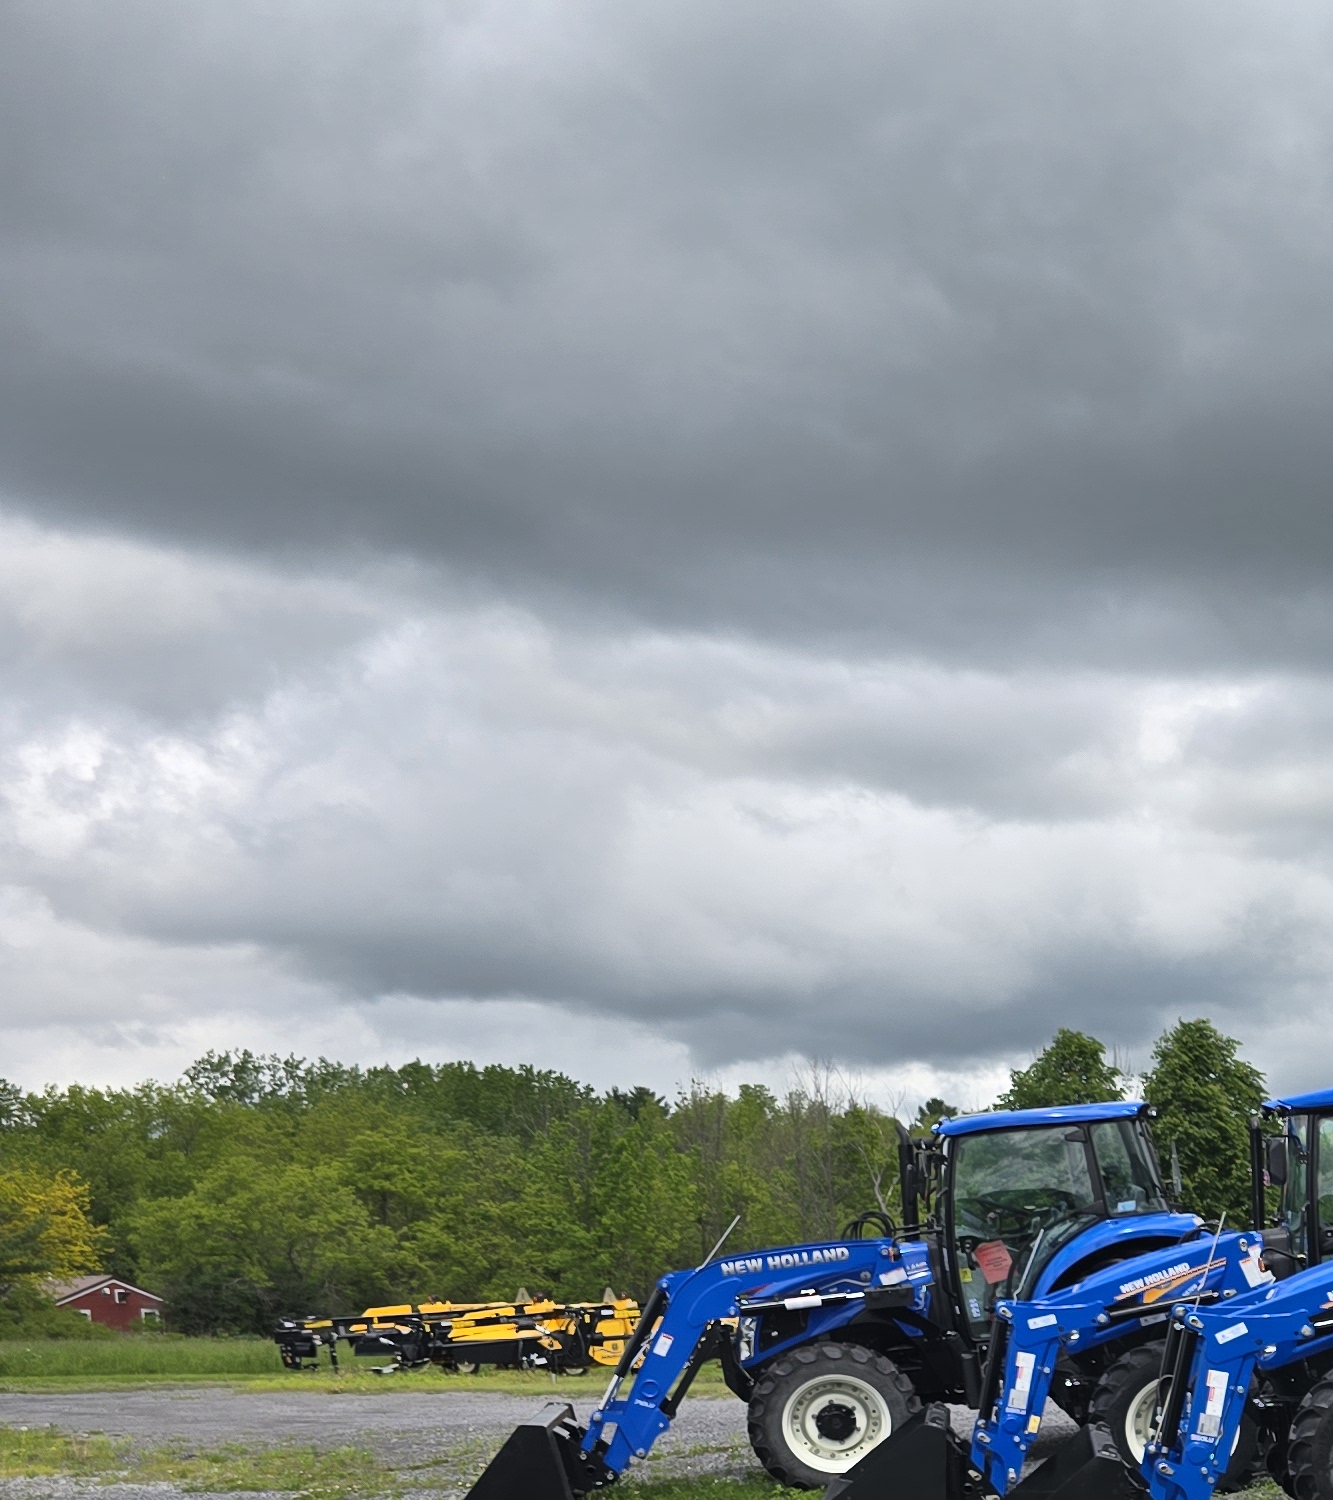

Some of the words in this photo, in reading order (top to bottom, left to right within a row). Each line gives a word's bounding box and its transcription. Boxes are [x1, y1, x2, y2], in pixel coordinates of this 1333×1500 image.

[720, 1257, 763, 1277] NEW
[767, 1246, 850, 1271] HOLLAND
[1118, 1277, 1146, 1294] NEW
[1144, 1261, 1191, 1286] HOLLAND
